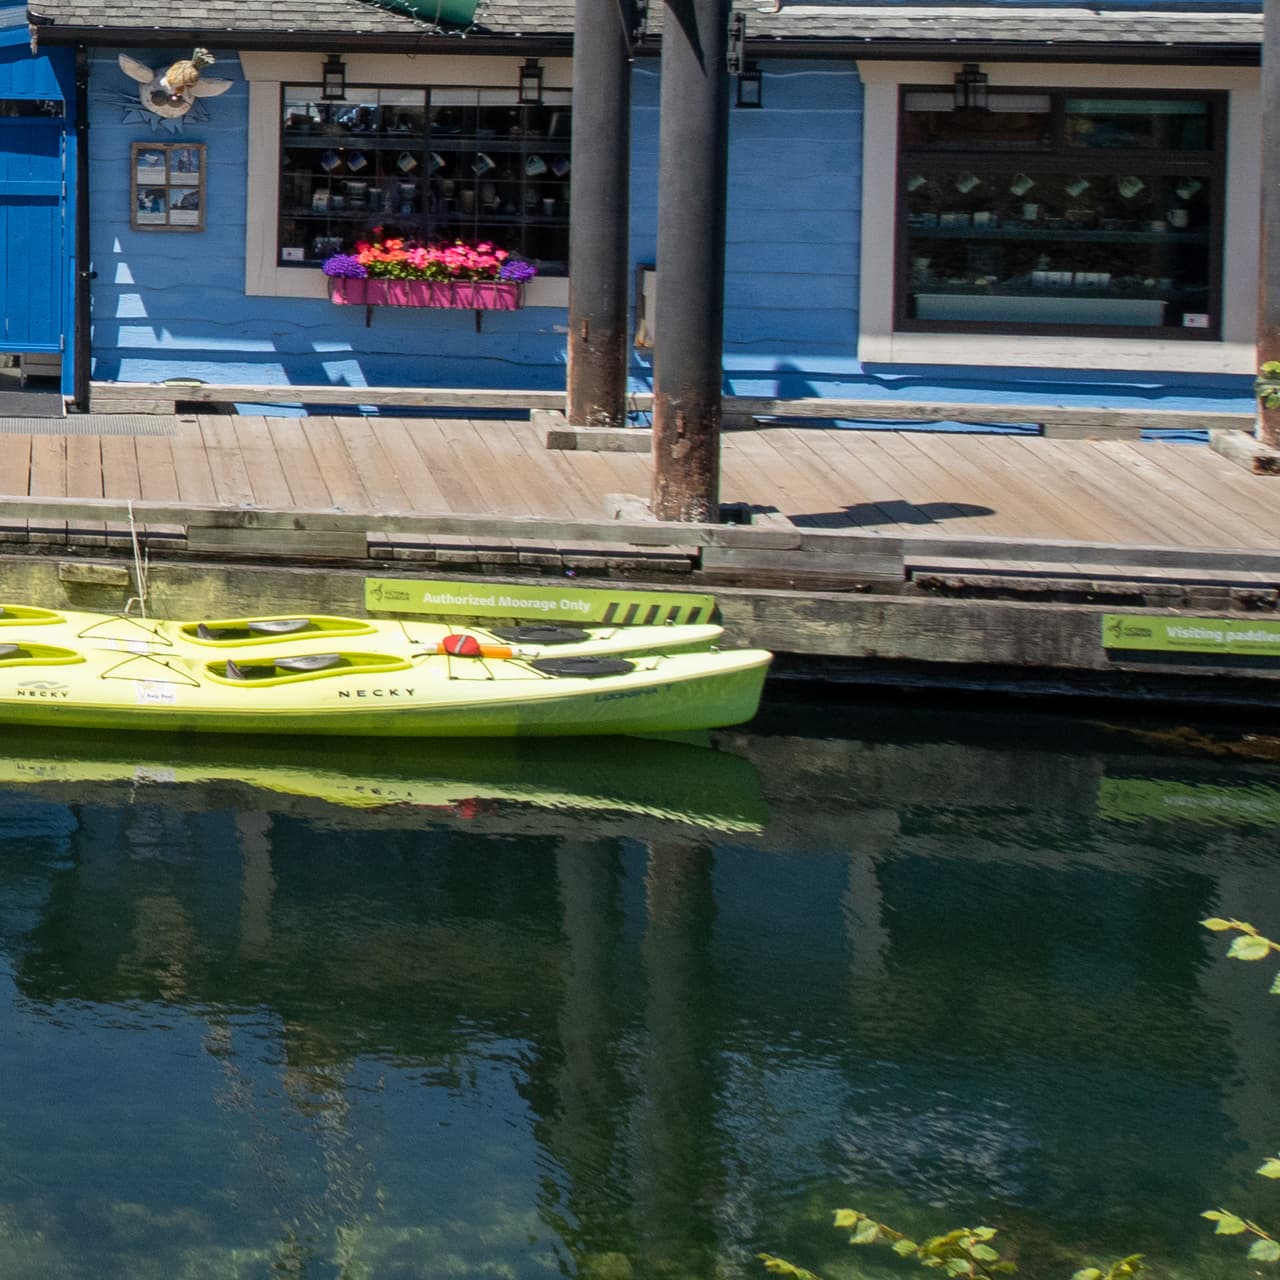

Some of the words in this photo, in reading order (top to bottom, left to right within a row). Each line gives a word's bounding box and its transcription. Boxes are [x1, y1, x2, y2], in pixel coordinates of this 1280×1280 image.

[423, 592, 496, 607] Authorized
[498, 598, 557, 612] Moorage
[559, 600, 591, 612] Only
[1166, 626, 1223, 642] Visiting
[17, 690, 70, 698] NECKY
[338, 688, 415, 698] NECKY
